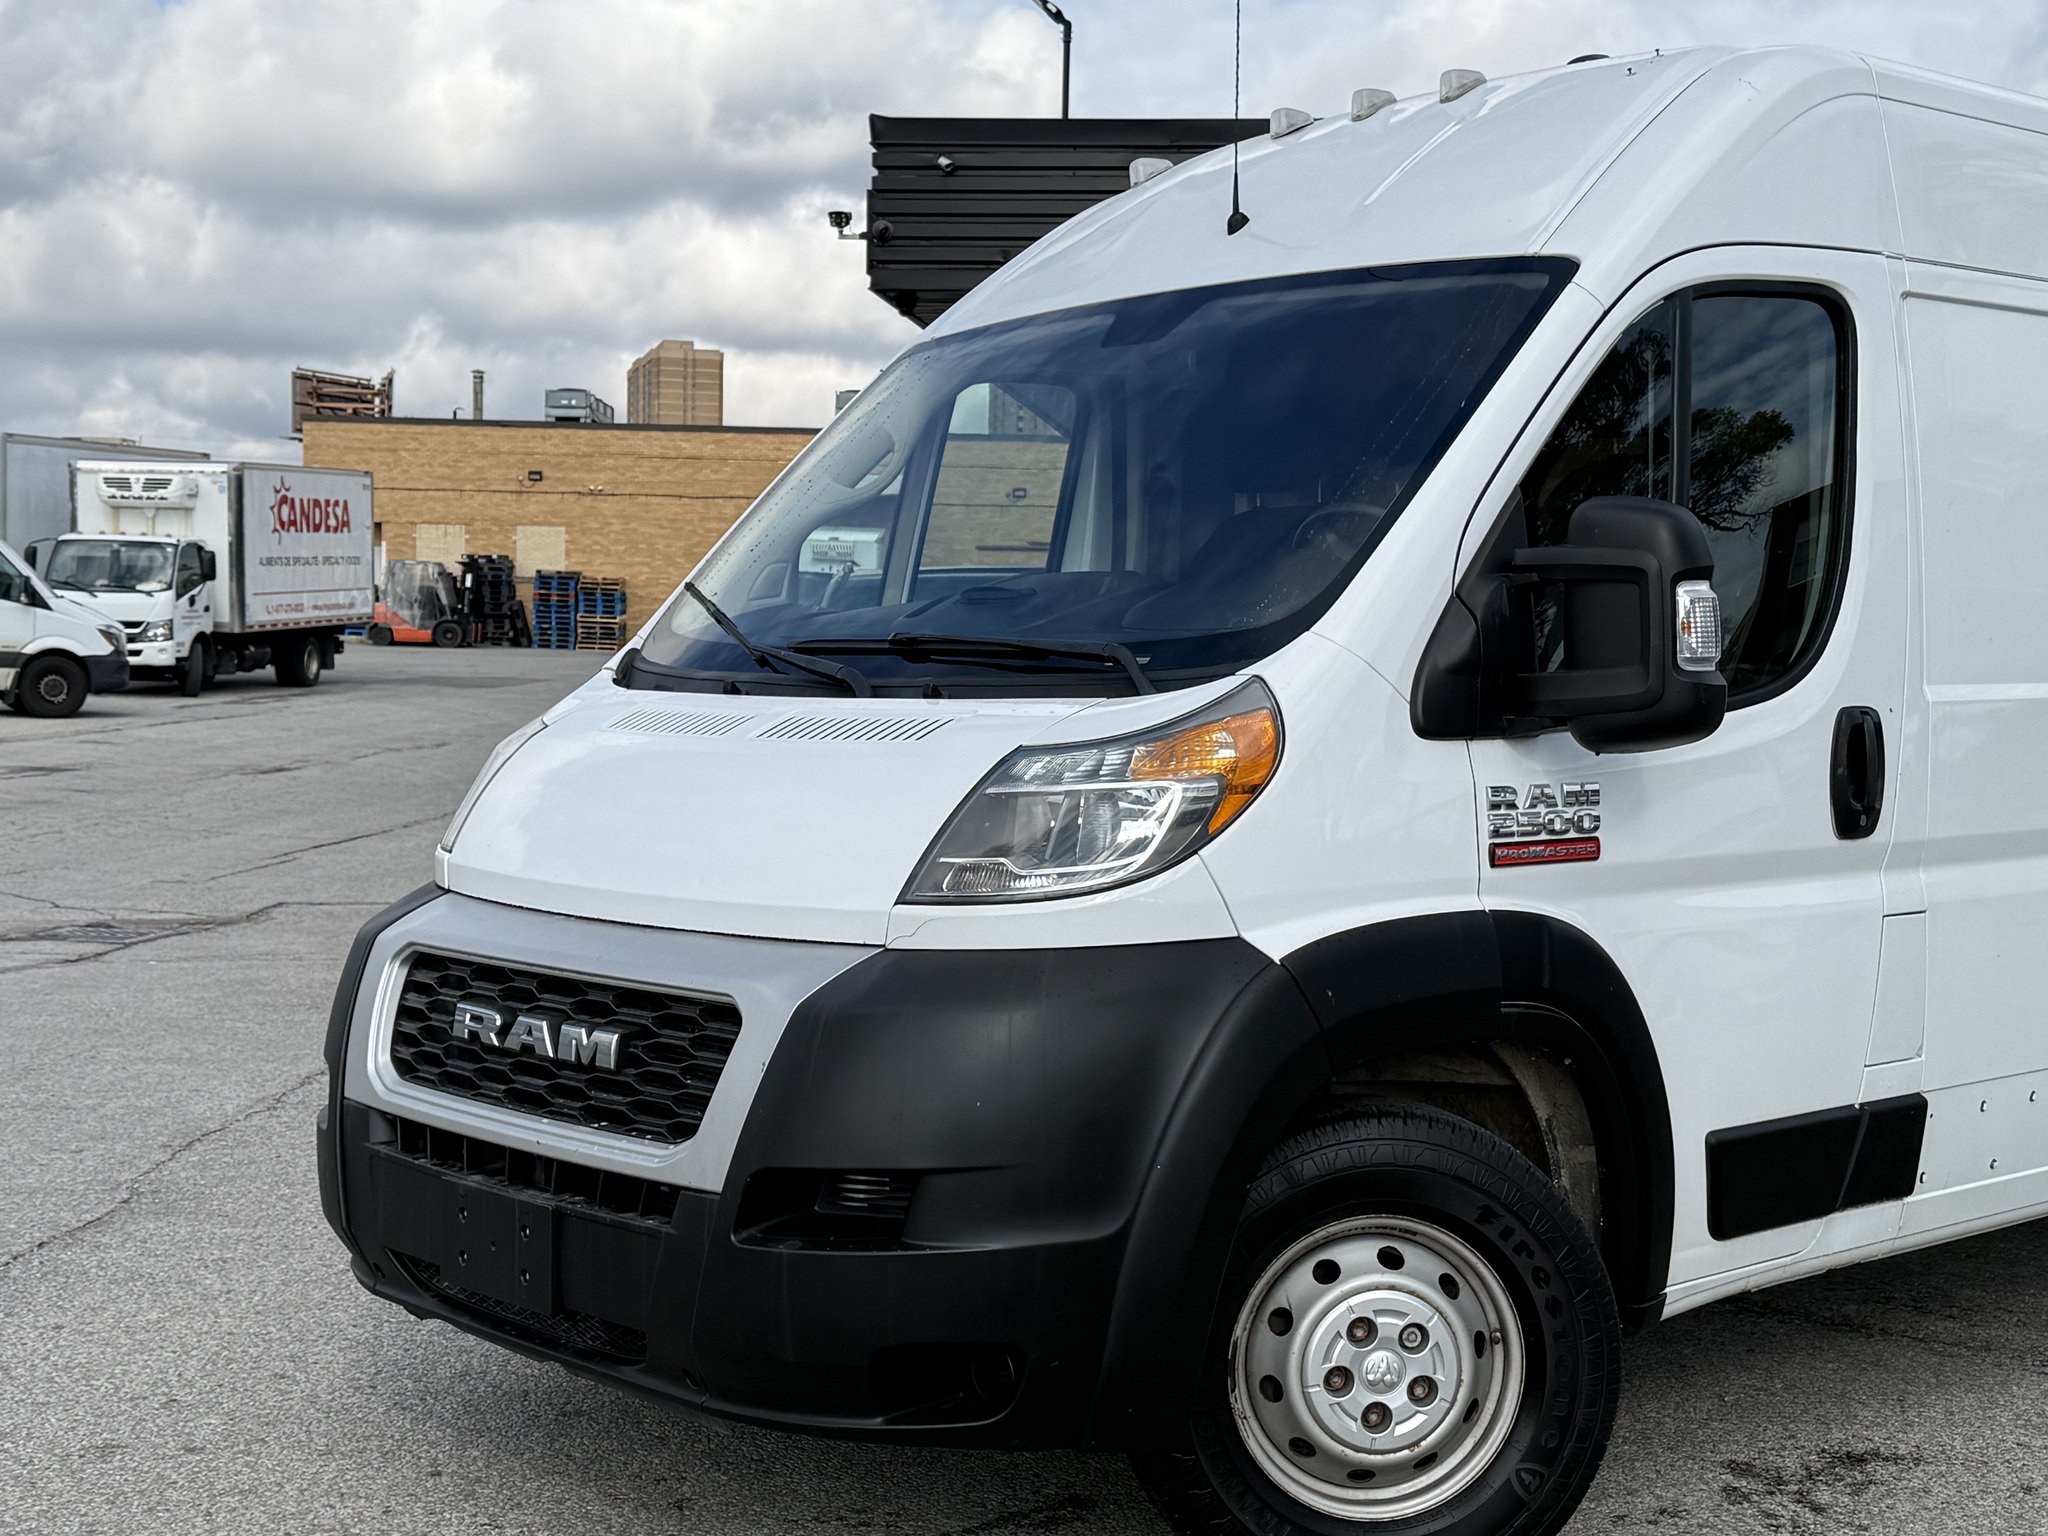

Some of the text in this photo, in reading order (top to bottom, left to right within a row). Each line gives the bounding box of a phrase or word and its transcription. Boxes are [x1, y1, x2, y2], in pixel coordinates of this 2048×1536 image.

[277, 494, 351, 534] CANDESA
[1485, 781, 1601, 812] RAM
[1487, 807, 1601, 839] 2500
[452, 1001, 620, 1071] RAM
